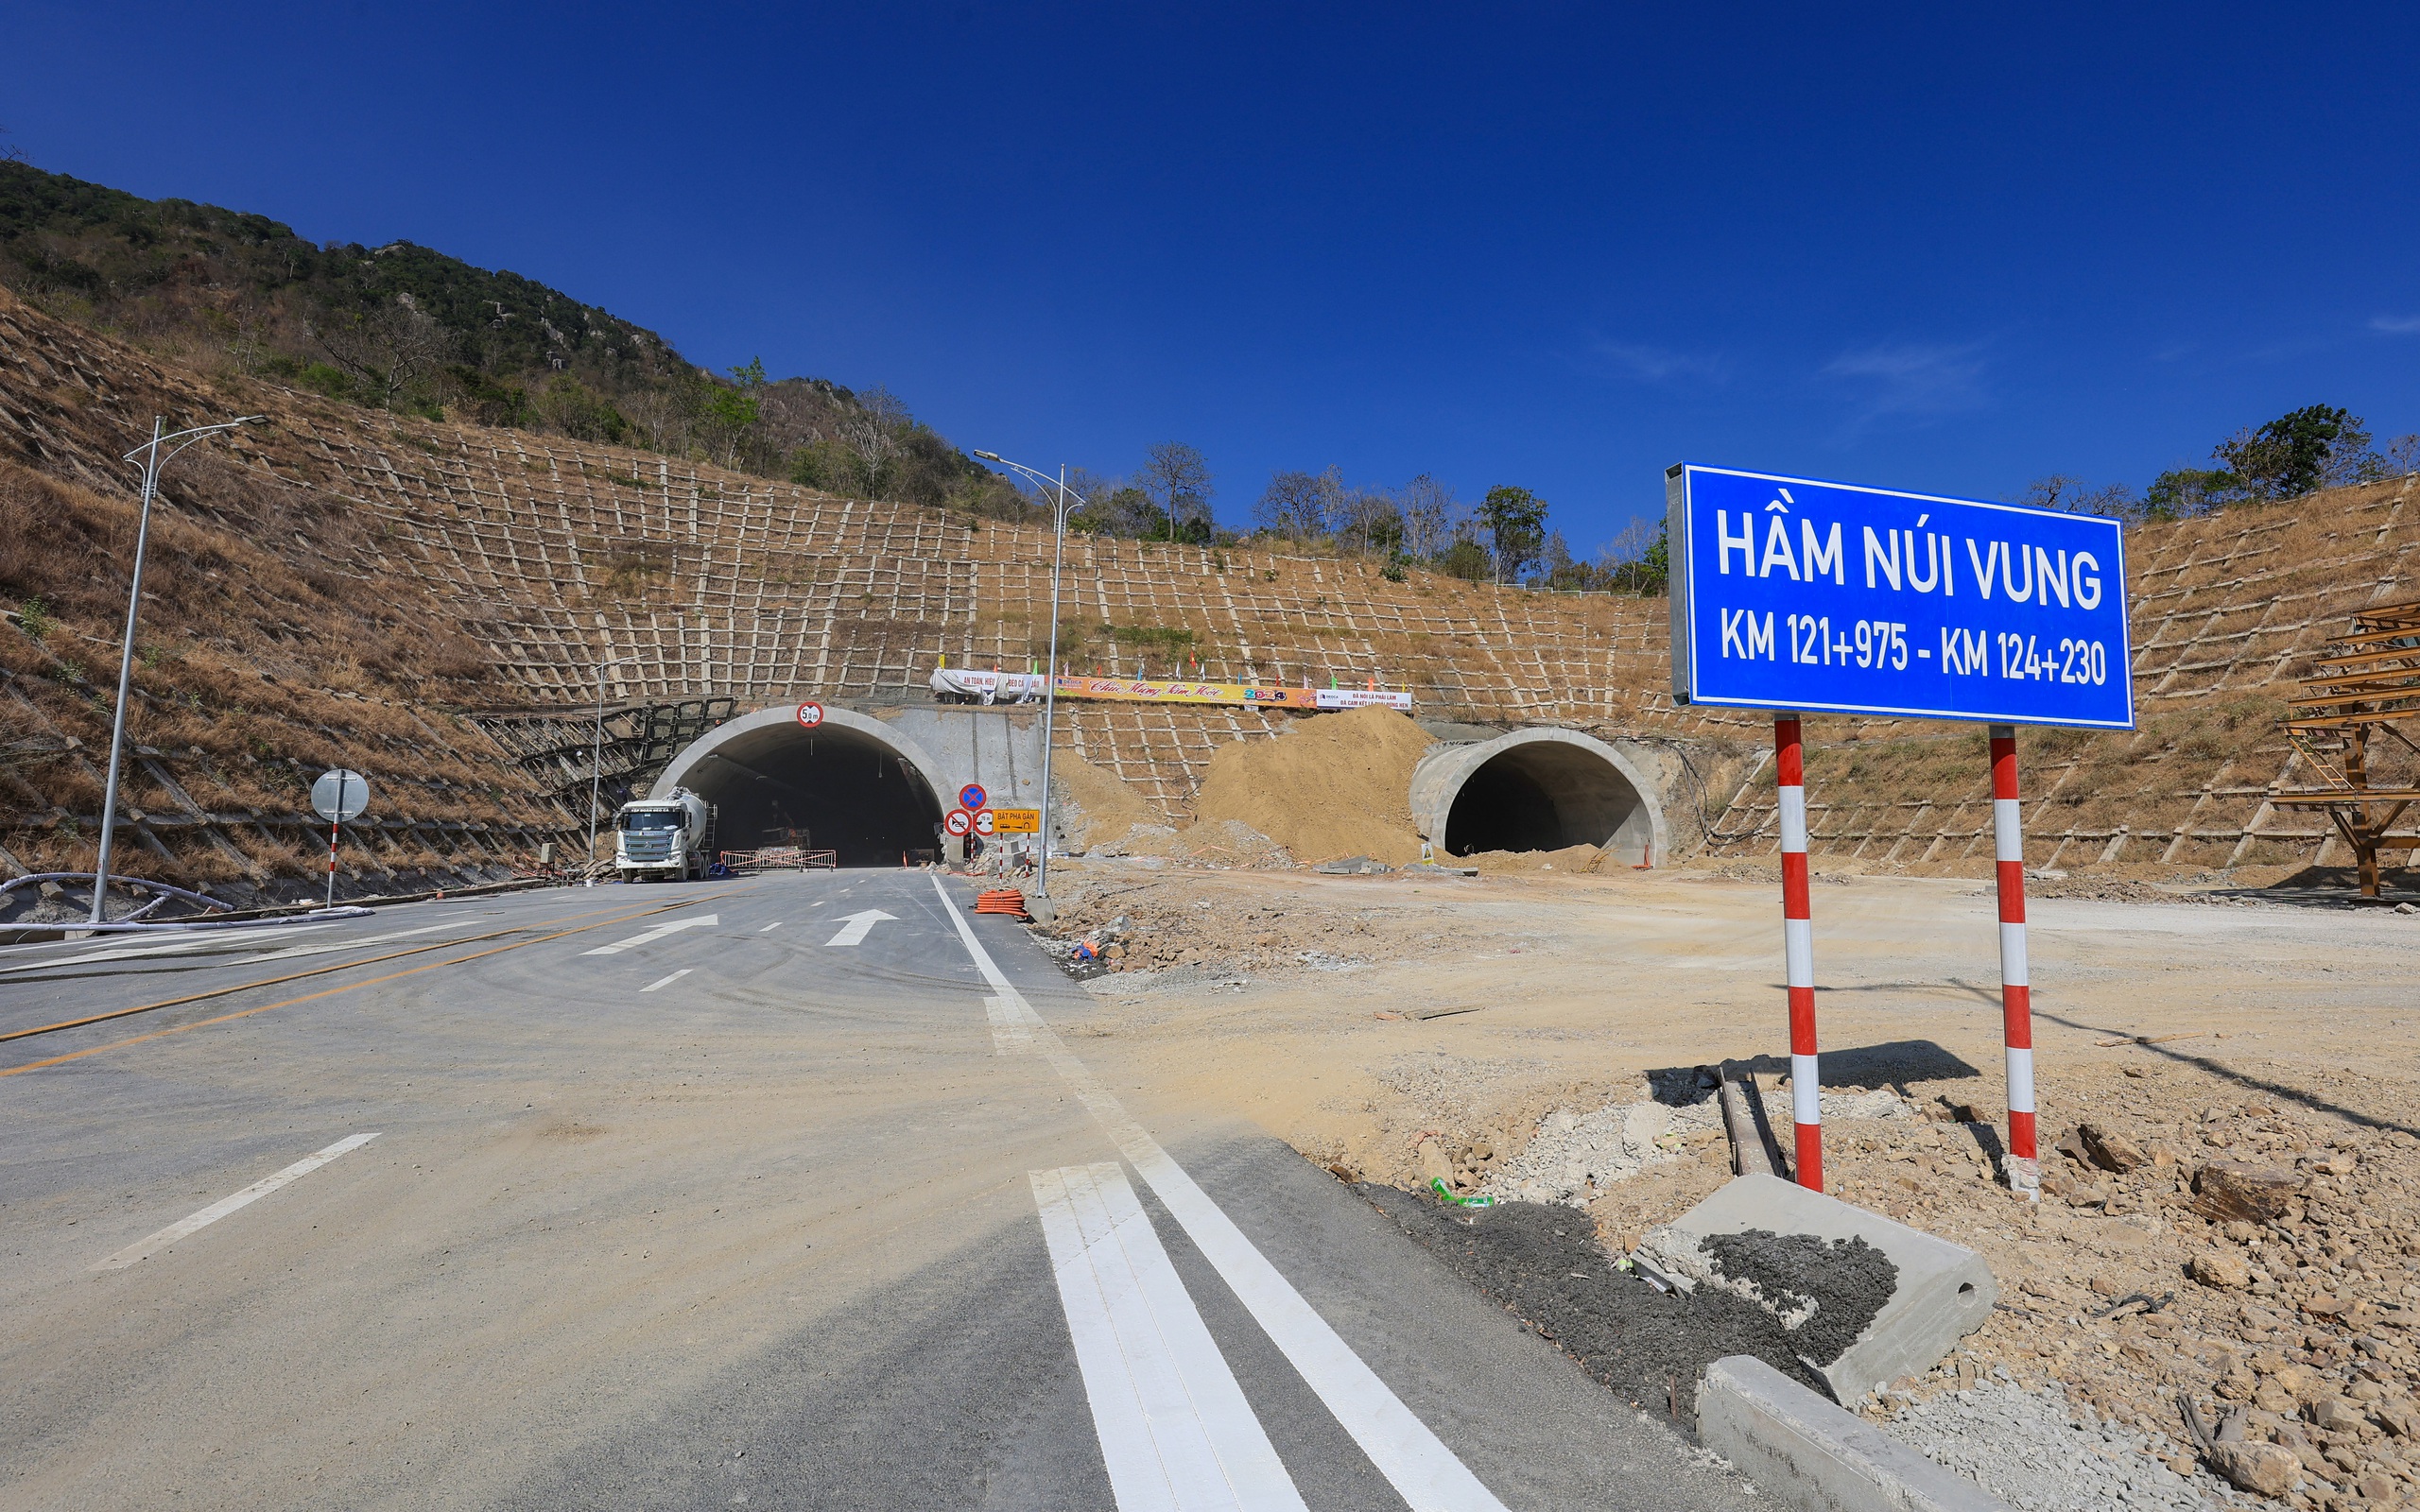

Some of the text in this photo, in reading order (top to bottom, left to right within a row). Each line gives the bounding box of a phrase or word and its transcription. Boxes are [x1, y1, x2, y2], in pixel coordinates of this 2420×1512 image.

[1718, 489, 2101, 610] HẦM NÚI VUNG
[1721, 608, 1775, 662] KM
[1787, 613, 1908, 671] 121+975
[1942, 627, 1988, 677] KM
[1997, 632, 2106, 686] 124+230
[1244, 688, 1287, 702] 2024
